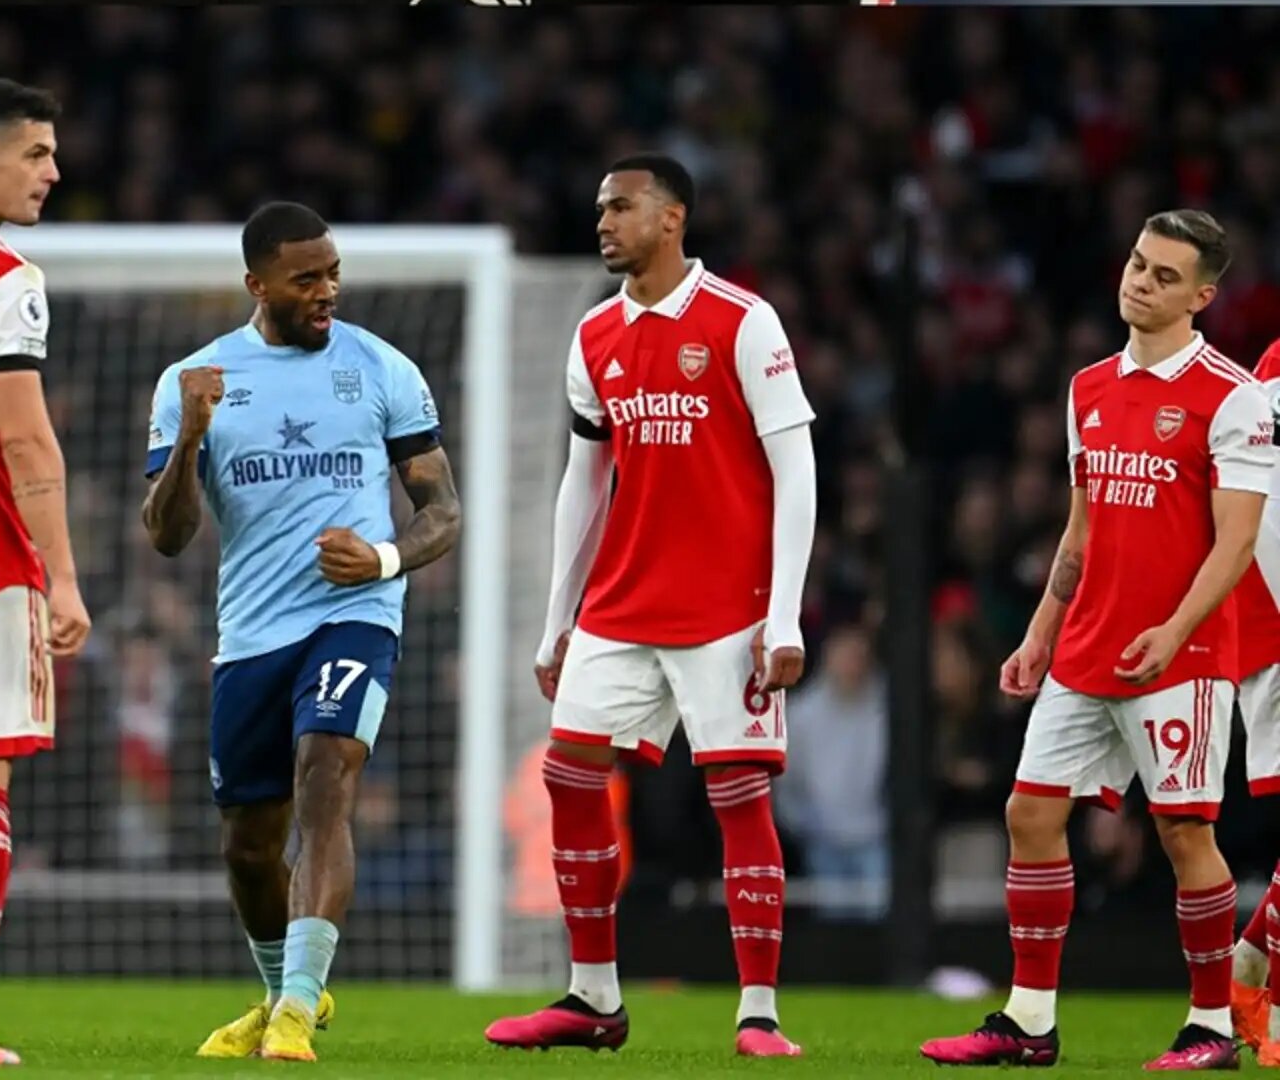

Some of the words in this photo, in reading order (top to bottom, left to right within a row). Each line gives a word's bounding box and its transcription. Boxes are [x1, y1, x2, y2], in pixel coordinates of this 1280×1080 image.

[606, 387, 709, 426] Emirates
[232, 451, 364, 487] HOLLYWOOD
[1082, 445, 1178, 482] mirates
[1104, 479, 1157, 508] BETTER
[316, 659, 368, 702] 17
[743, 671, 771, 717] 6
[1143, 718, 1191, 769] 19
